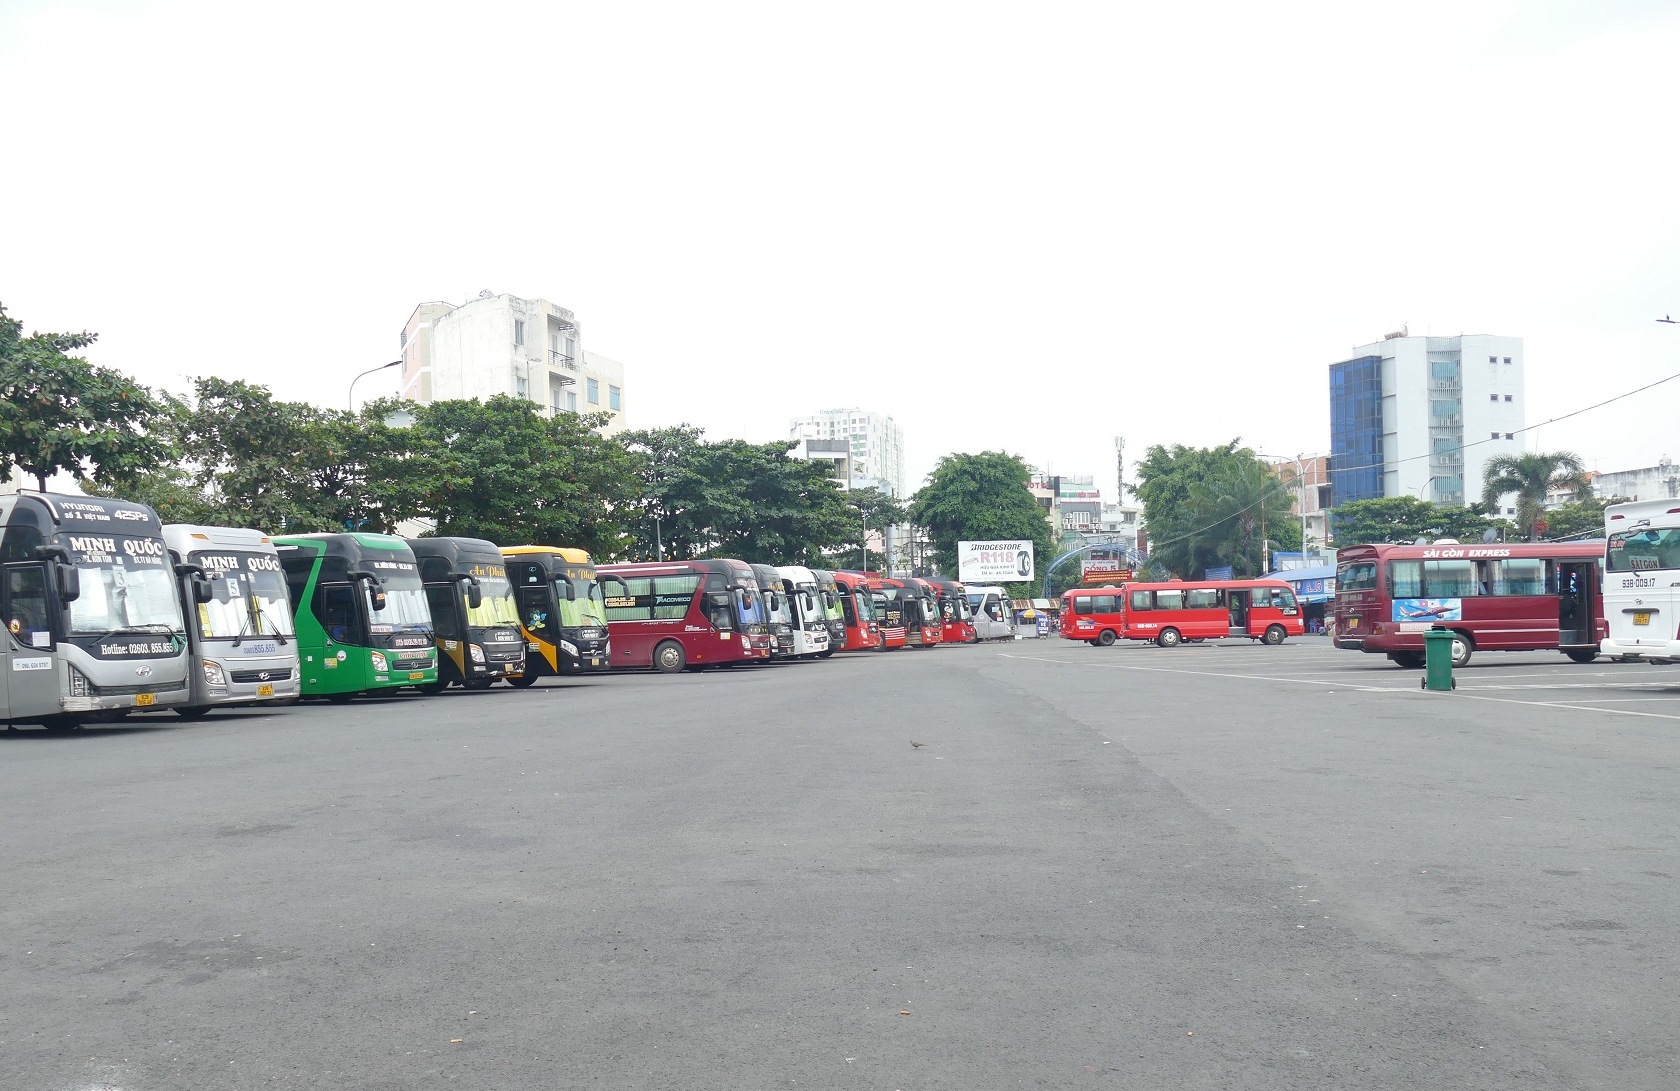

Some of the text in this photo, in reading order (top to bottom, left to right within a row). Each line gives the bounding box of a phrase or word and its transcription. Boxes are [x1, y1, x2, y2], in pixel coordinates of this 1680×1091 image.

[69, 537, 163, 556] MINH QUỐC
[971, 543, 1022, 551] BRIDGESTONE
[980, 551, 1014, 563] R118
[1423, 548, 1511, 558] SÀI GÒN EXPRESS
[200, 555, 280, 572] MINH QUỐC
[117, 572, 125, 585] 3
[230, 582, 238, 595] 5
[101, 644, 129, 655] Hotline:
